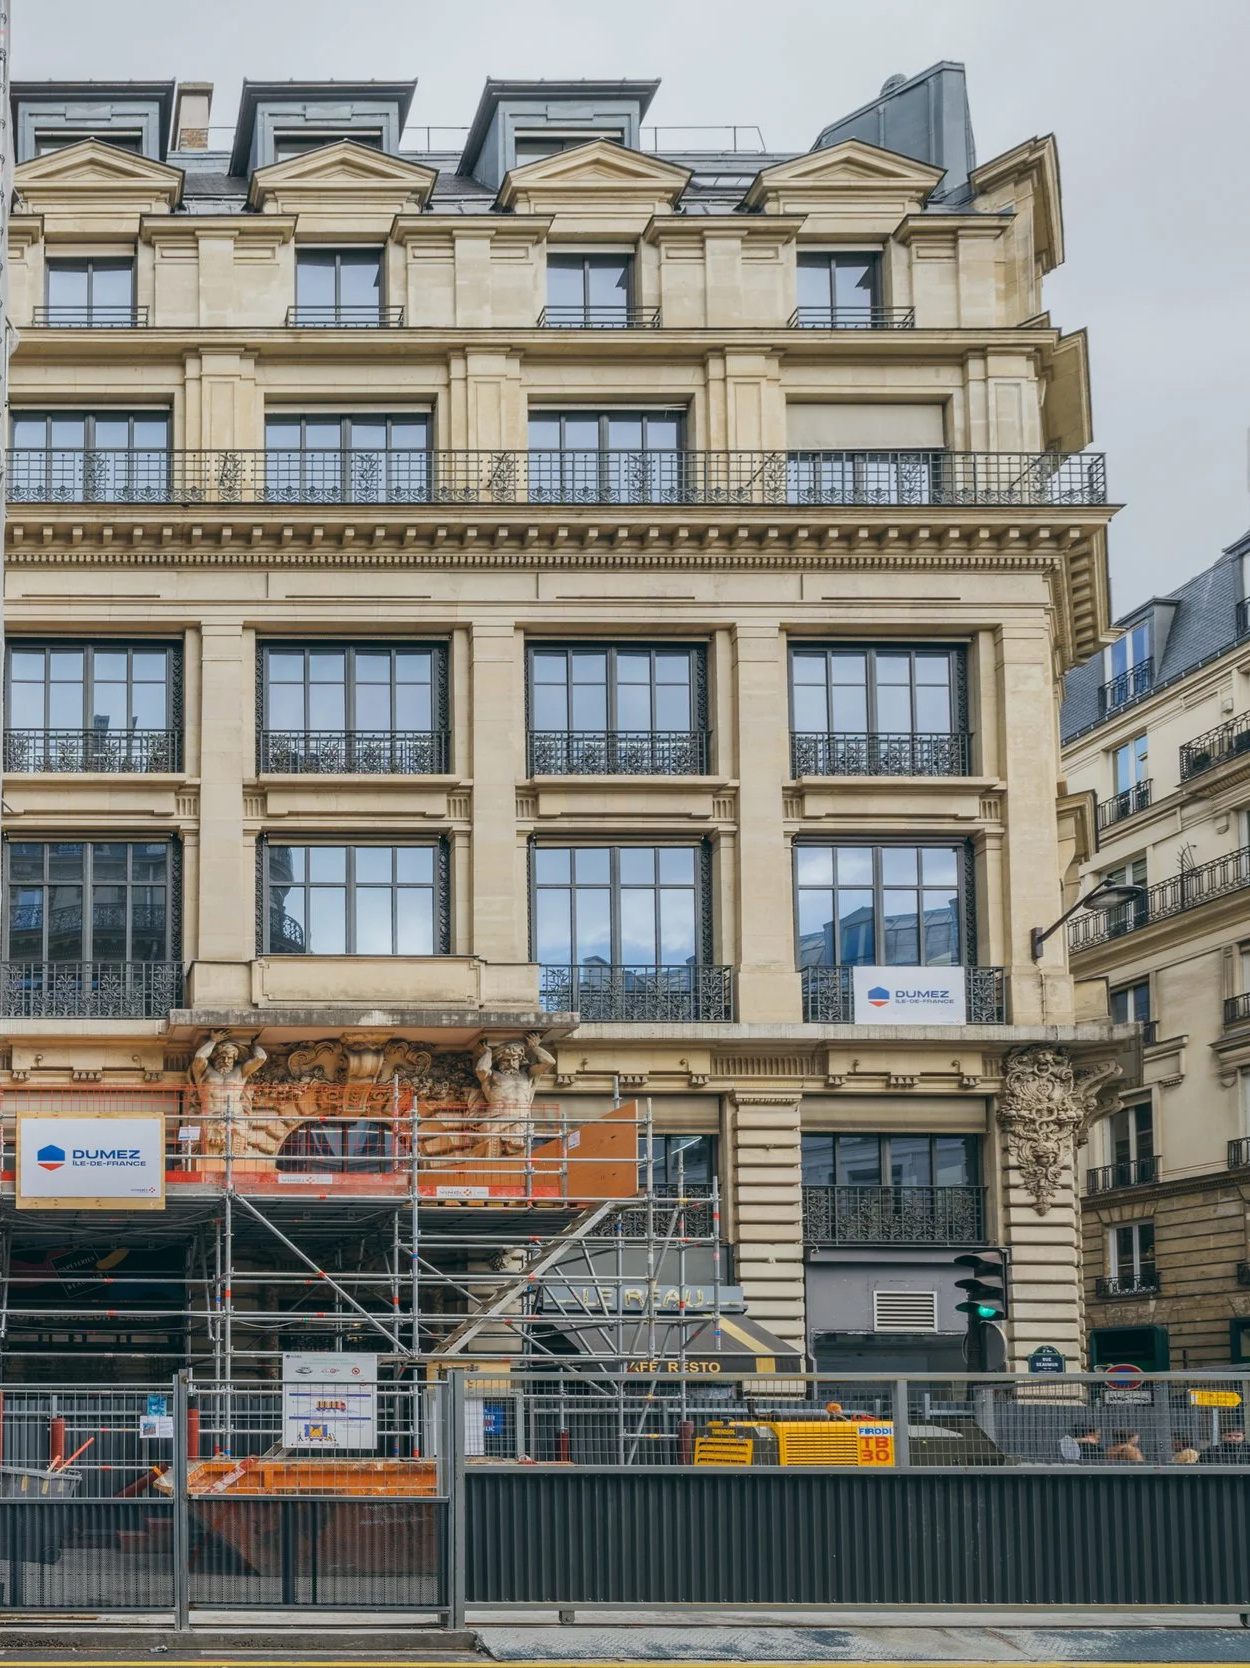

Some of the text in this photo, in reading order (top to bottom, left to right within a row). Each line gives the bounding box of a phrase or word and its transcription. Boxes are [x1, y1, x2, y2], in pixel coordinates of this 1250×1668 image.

[72, 1149, 141, 1159] DUMEZ
[582, 1287, 613, 1307] LE
[668, 1361, 721, 1373] RESTO
[860, 1436, 890, 1449] TB
[861, 1449, 890, 1462] 30
